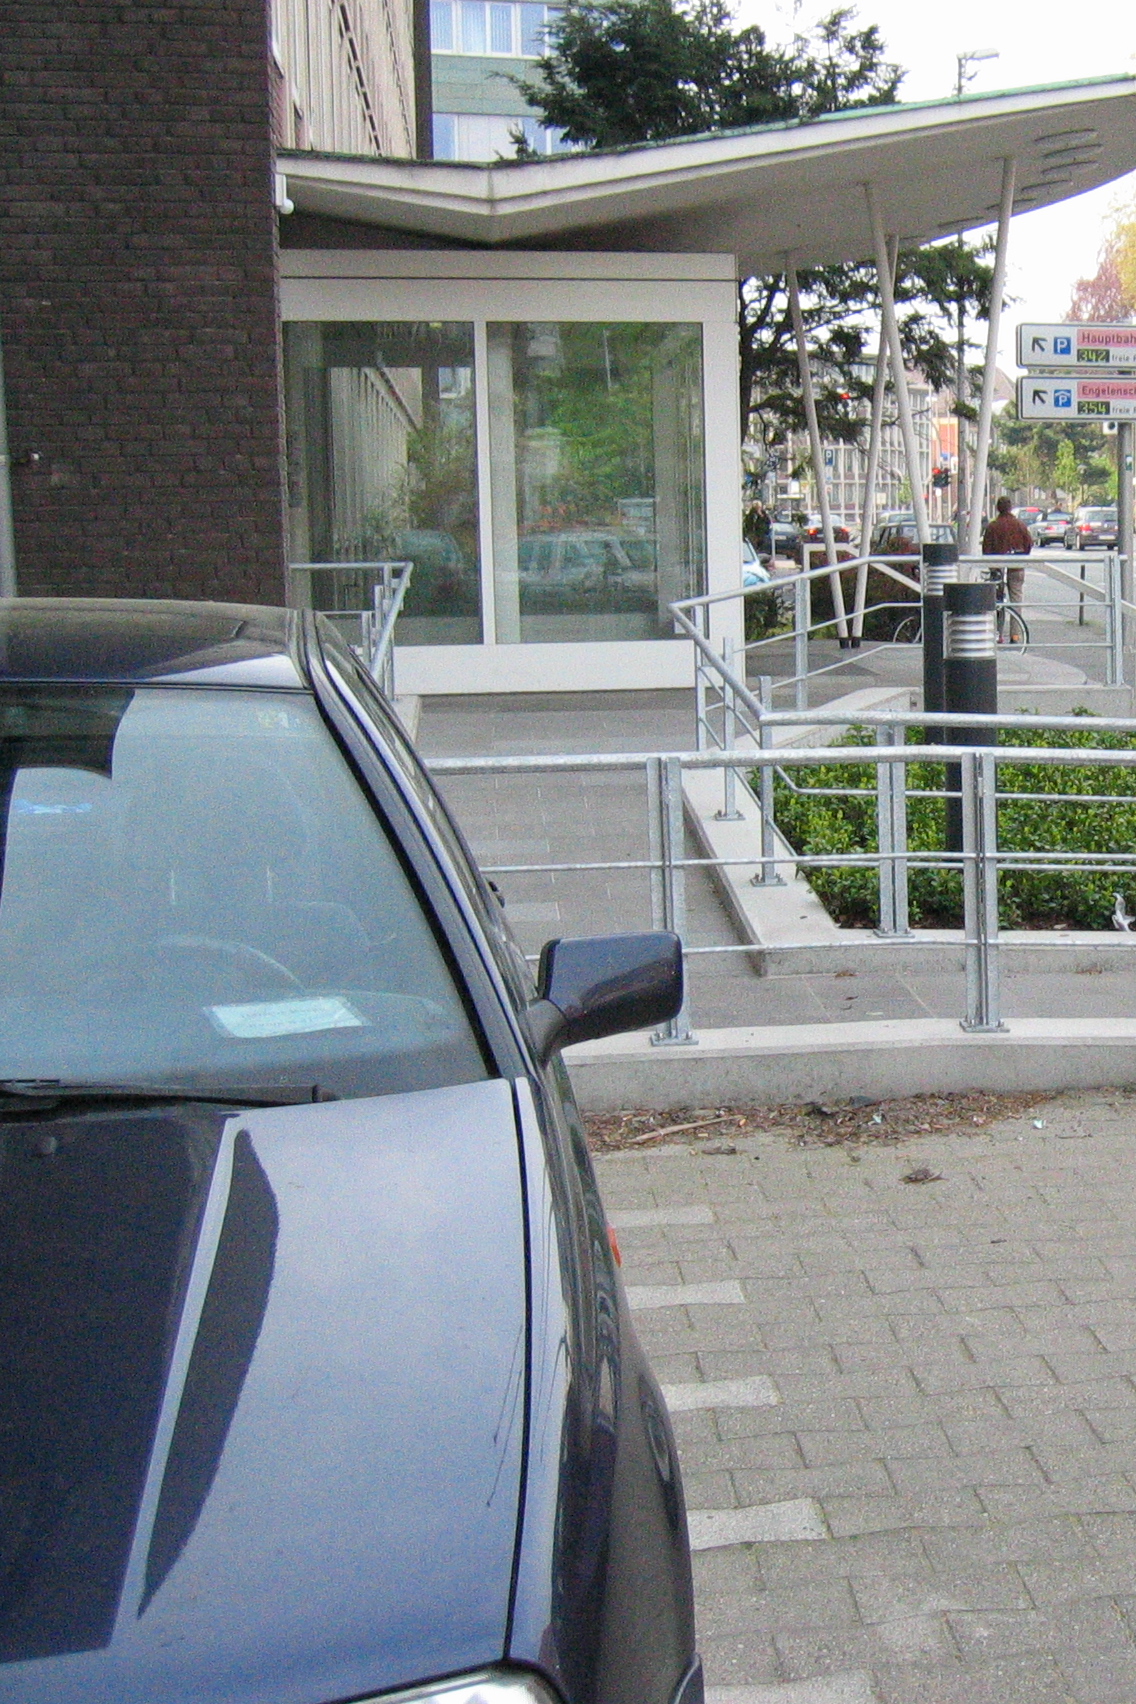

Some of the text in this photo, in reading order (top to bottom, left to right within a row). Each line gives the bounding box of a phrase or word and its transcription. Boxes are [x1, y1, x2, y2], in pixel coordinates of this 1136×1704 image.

[1057, 338, 1068, 353] P
[1078, 349, 1109, 362] 342
[1111, 354, 1130, 362] freie
[1078, 401, 1108, 415] 354
[1111, 406, 1130, 414] freie
